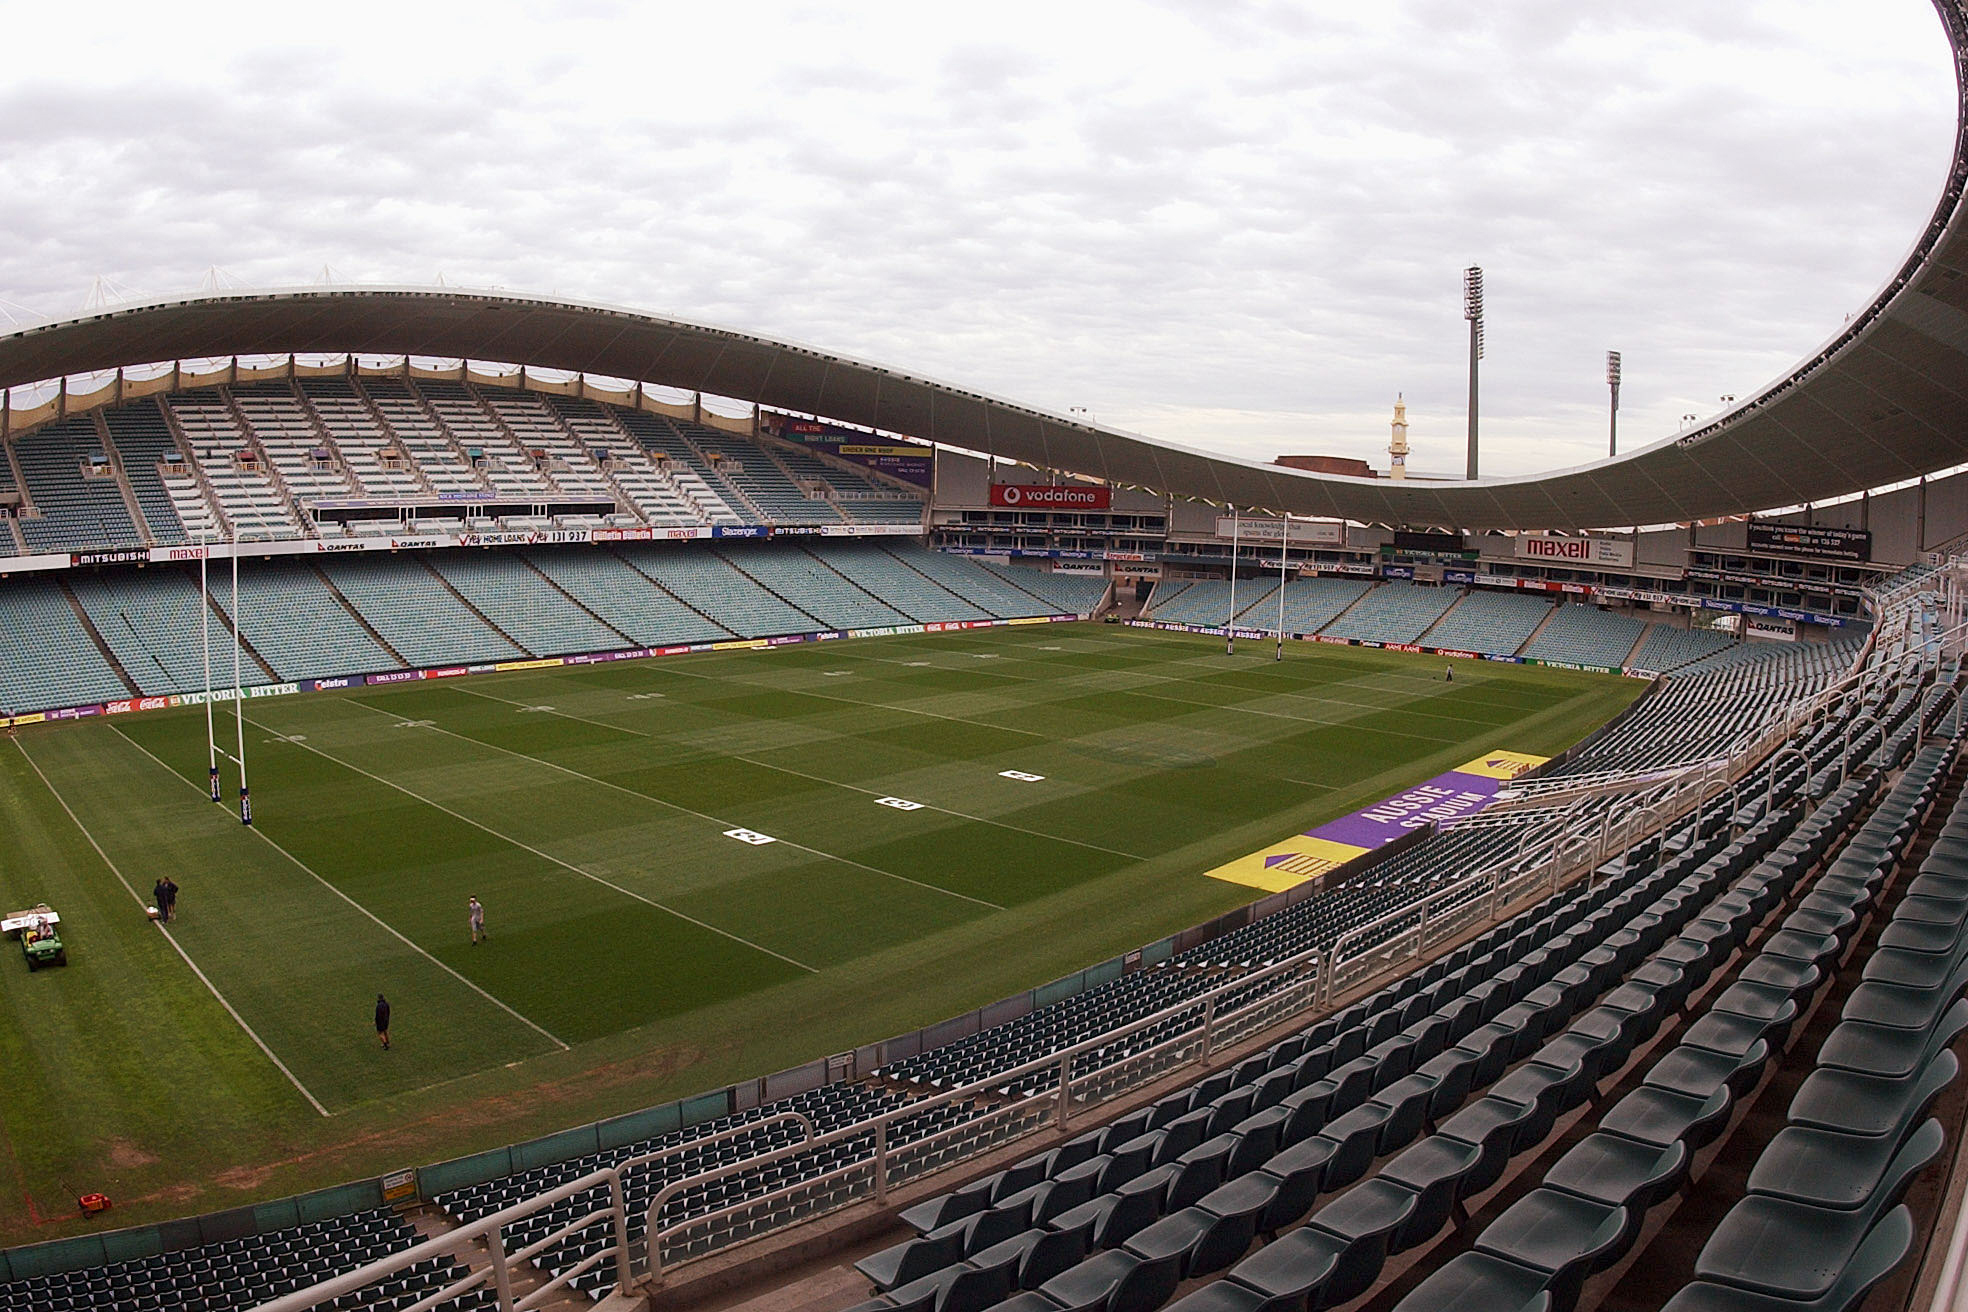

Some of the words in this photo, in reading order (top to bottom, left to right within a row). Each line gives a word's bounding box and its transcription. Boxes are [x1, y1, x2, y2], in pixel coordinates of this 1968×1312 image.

[1026, 489, 1095, 503] vodafone
[552, 531, 566, 542] 131
[568, 530, 587, 541] 937
[721, 527, 758, 538] Slazenger
[327, 543, 365, 551] QANTAS
[400, 541, 437, 549] QANTAS
[1527, 540, 1590, 559] maxell
[80, 551, 150, 565] MITSUBISHI
[1063, 563, 1101, 571] QANTAS
[1125, 566, 1159, 574] QANTAS
[855, 627, 893, 637] VICTORIA
[1756, 623, 1794, 635] QANTAS
[1546, 661, 1580, 671] VICTORIA
[1583, 665, 1610, 674] BITTER
[250, 682, 299, 698] BITTER
[315, 679, 348, 690] Telstra
[1361, 785, 1456, 824] AUSSIE
[1400, 791, 1488, 828] STADIUM
